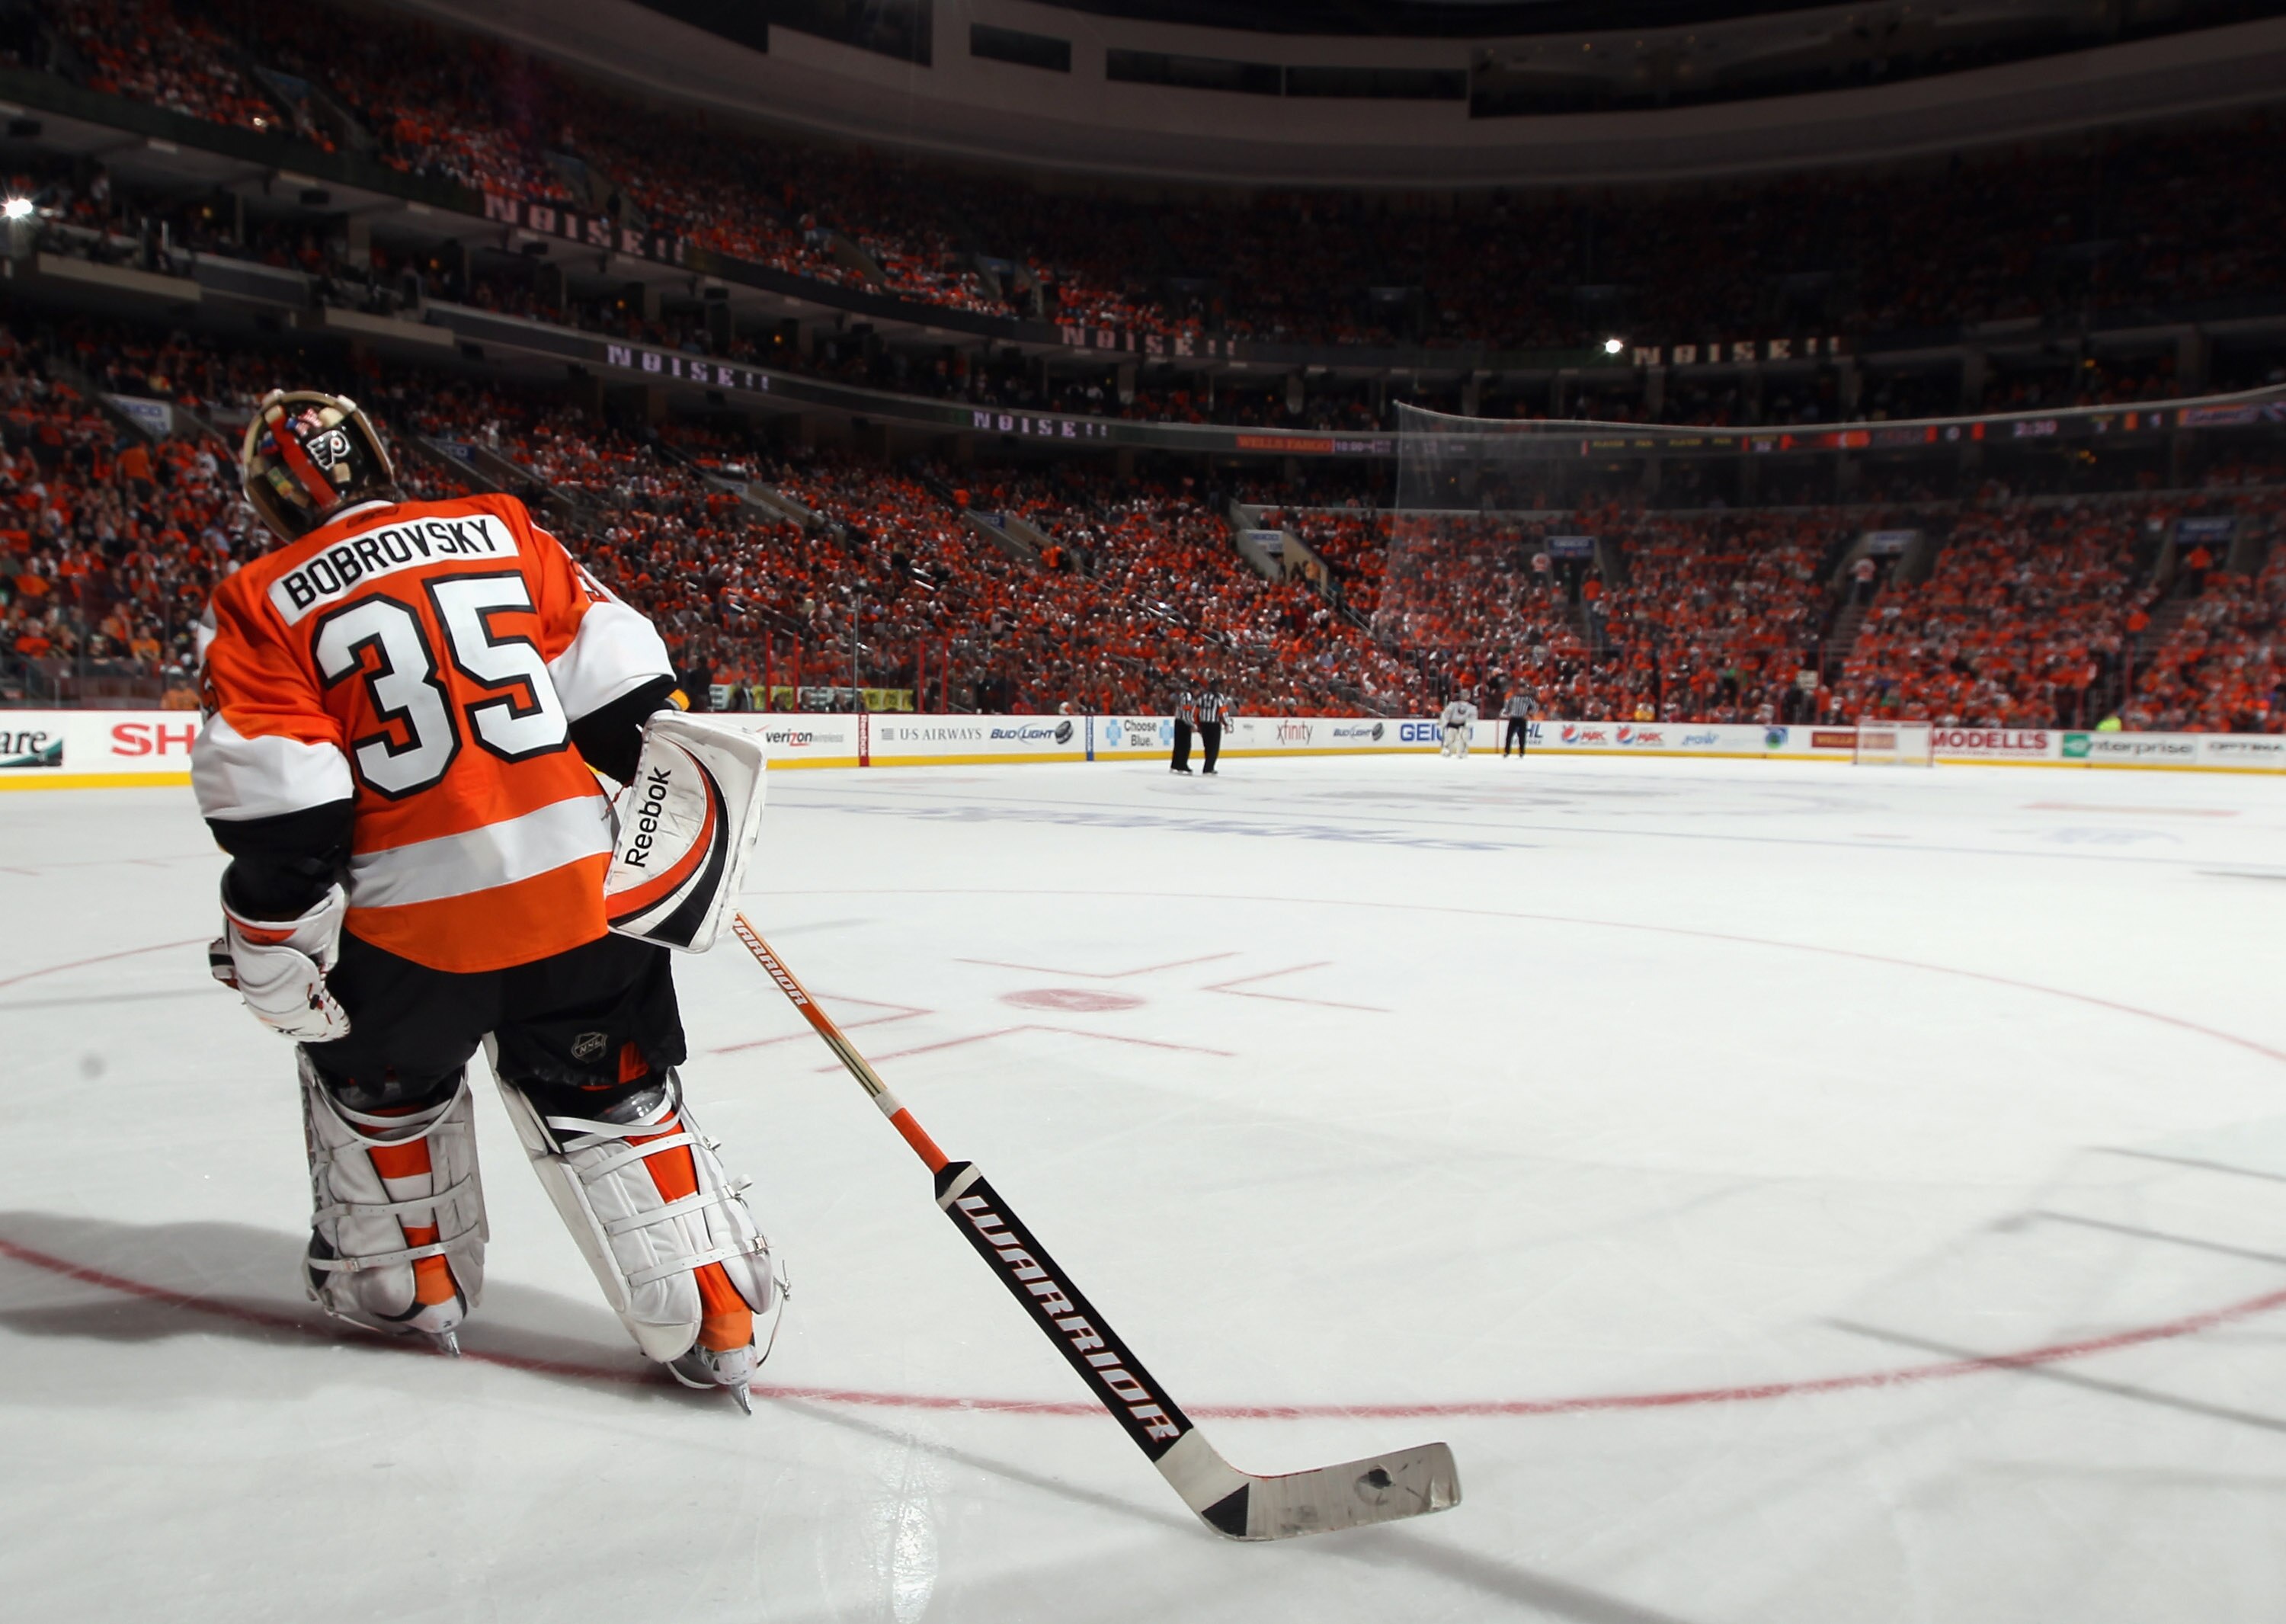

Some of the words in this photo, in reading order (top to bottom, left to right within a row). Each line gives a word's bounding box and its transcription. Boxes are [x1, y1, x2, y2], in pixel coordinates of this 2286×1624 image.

[281, 519, 496, 610] BOBROVSKY
[311, 569, 572, 802] 35
[922, 728, 982, 740] AIRWAYS
[989, 729, 1017, 739] BUD
[1021, 729, 1055, 739] LIGHT
[1124, 719, 1157, 732] Choose
[1276, 719, 1313, 745] xfinity
[766, 728, 812, 746] verizon
[1131, 733, 1154, 746] Blue.
[625, 766, 672, 868] Reebok
[578, 1038, 601, 1055] NHL
[955, 1194, 1181, 1443] WARRIOR
